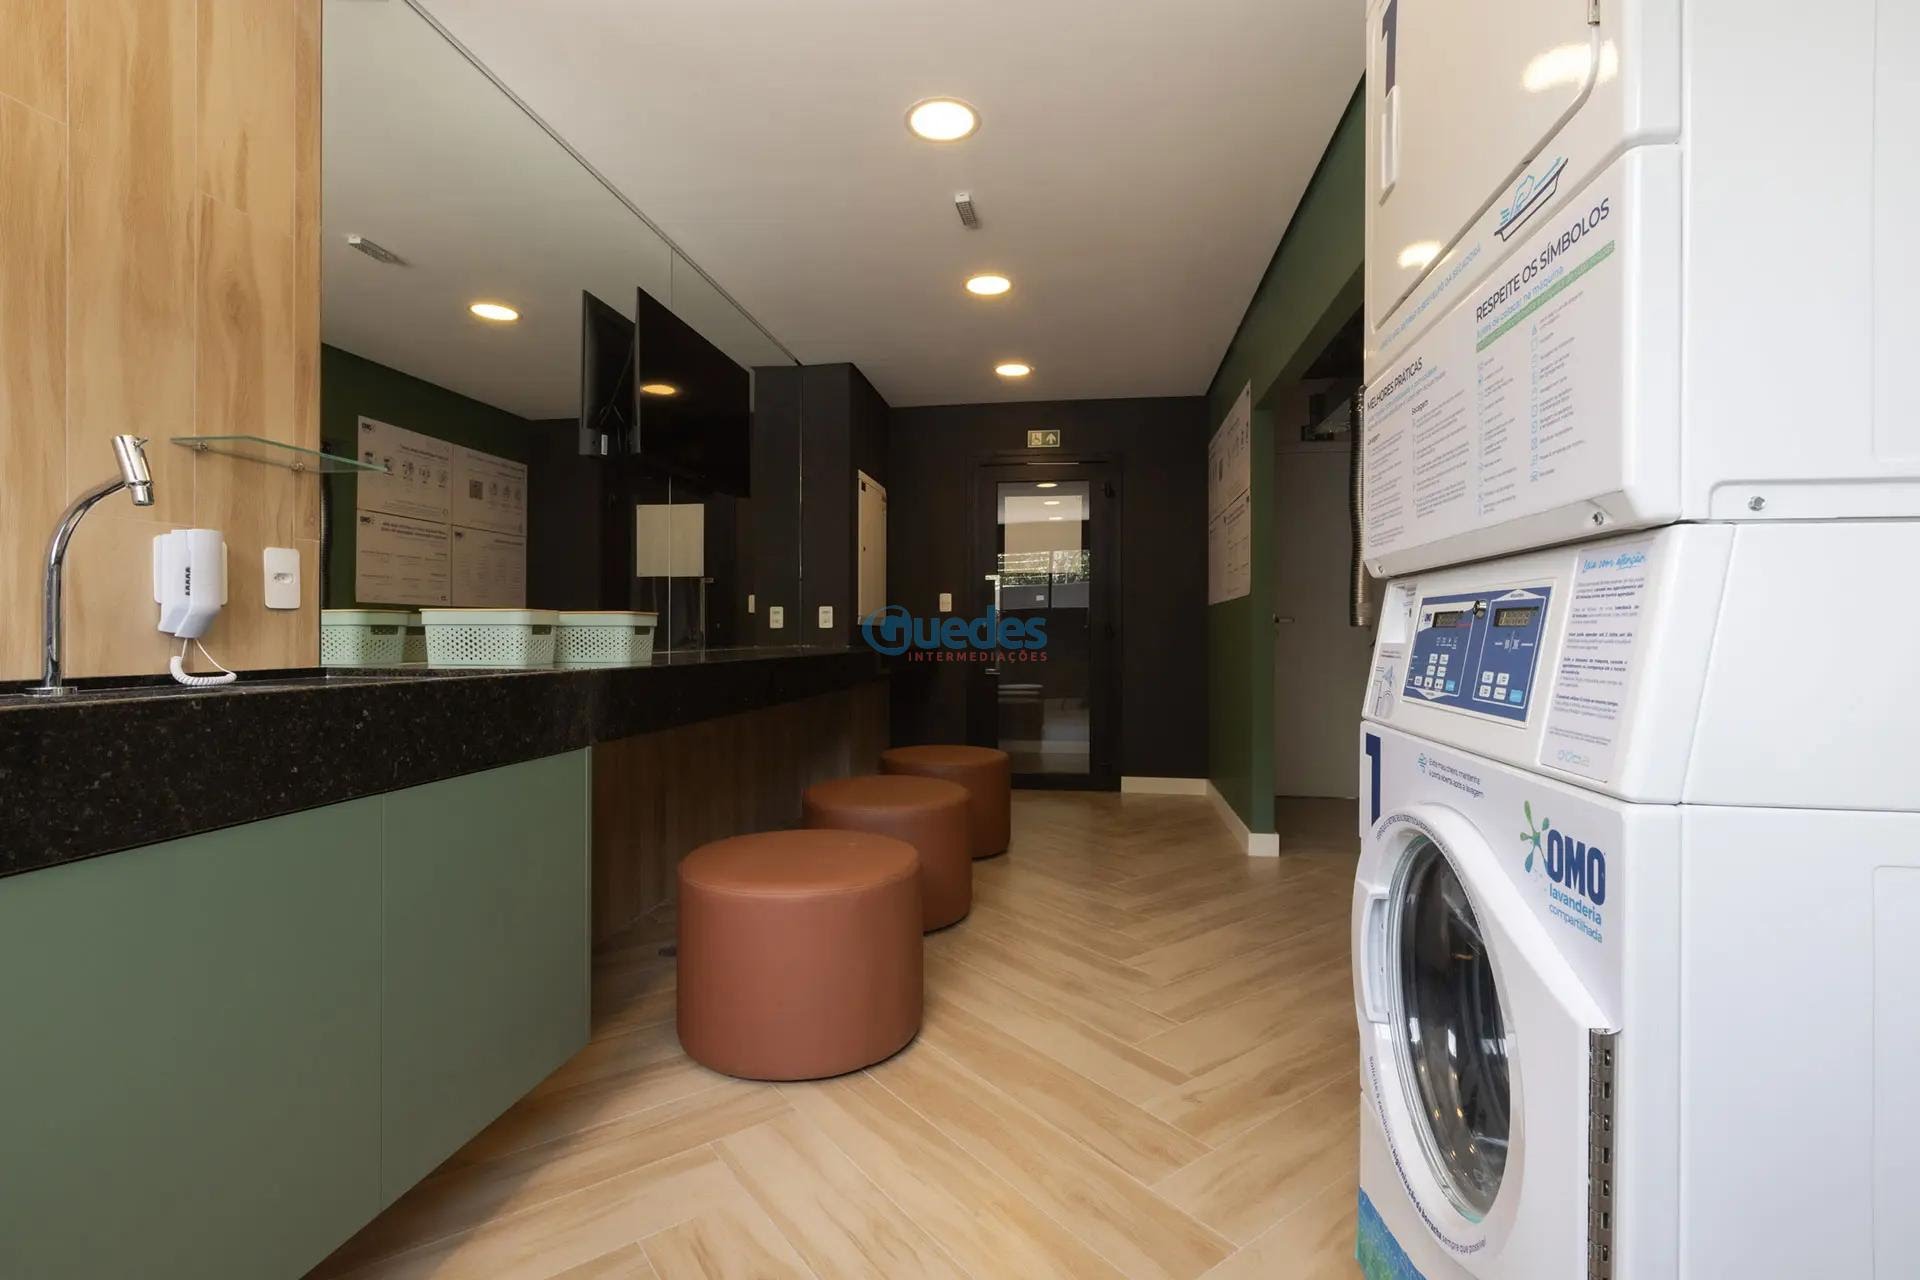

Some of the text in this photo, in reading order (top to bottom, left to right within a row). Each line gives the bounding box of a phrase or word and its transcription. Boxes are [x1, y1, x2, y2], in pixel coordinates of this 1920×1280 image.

[1476, 272, 1520, 323] RESPEITE
[1521, 258, 1538, 284] OS
[1539, 197, 1610, 271] SÍMBOLOS
[1365, 732, 1381, 827] 1
[1547, 829, 1605, 906] OMO
[1549, 883, 1601, 925] lavanderia
[1548, 904, 1602, 943] compartilhada
